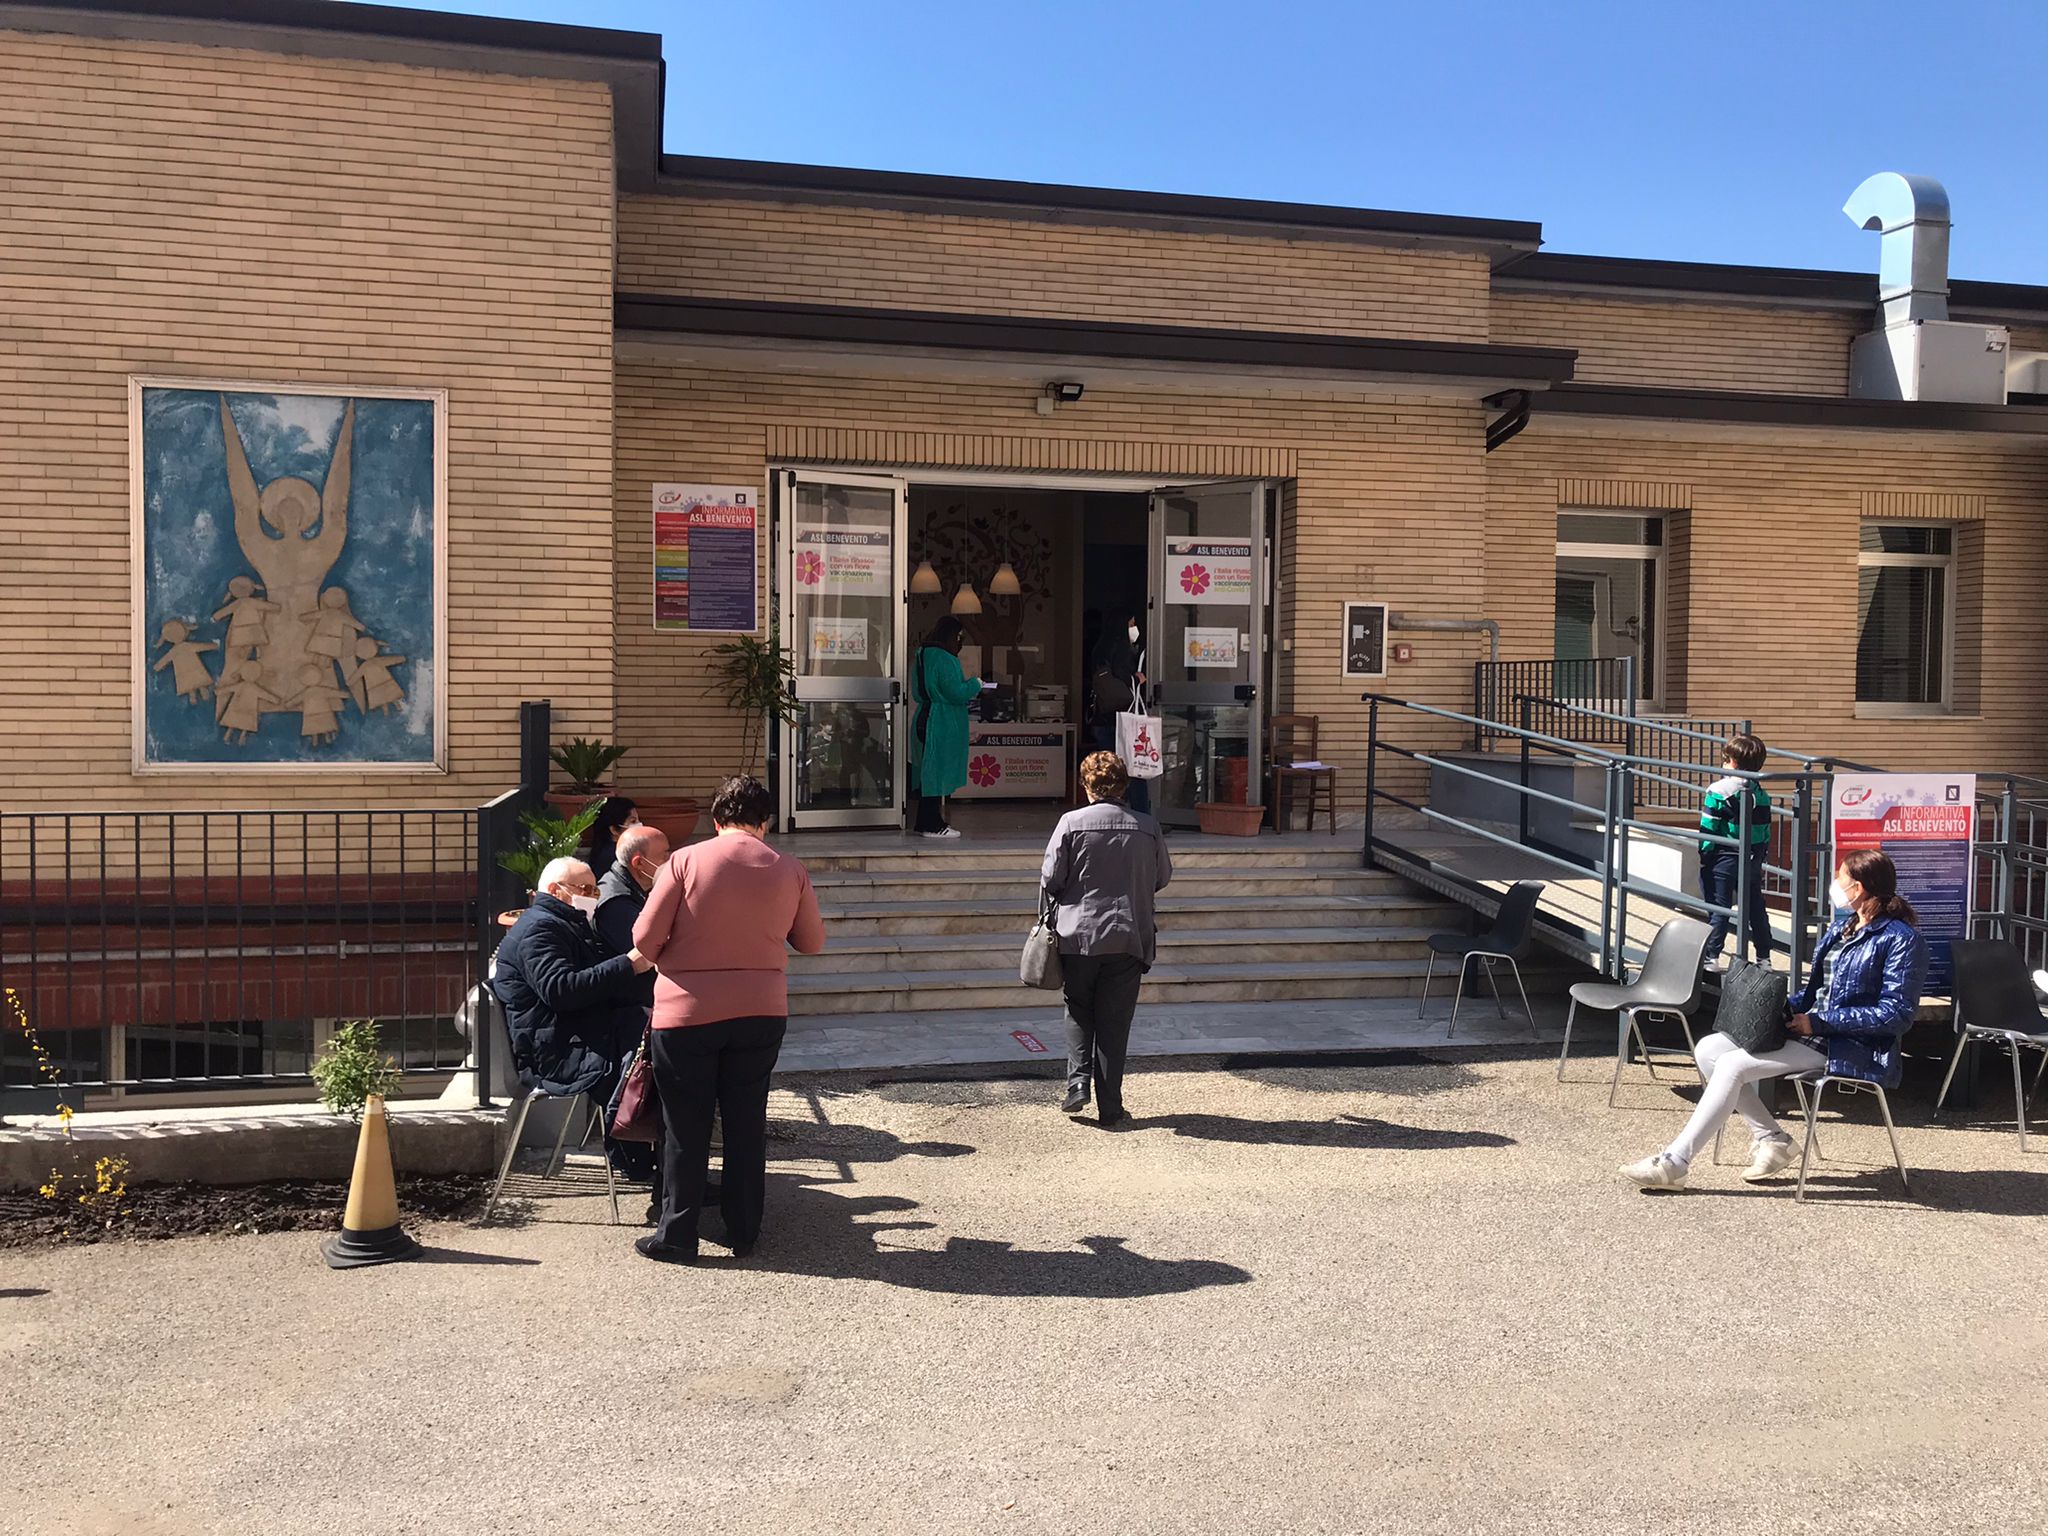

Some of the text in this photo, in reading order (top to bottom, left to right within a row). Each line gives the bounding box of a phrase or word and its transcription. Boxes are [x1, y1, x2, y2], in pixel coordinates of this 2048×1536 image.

[702, 507, 750, 515] INFORMATIVA
[690, 514, 752, 523] ASL BENEVENTO
[810, 533, 868, 544] ASL BENEVENTO
[1197, 547, 1249, 556] ASL BENEVENTO
[1900, 806, 1965, 819] INFORMATIVA
[1883, 819, 1966, 832] ASL BENEVENTO
